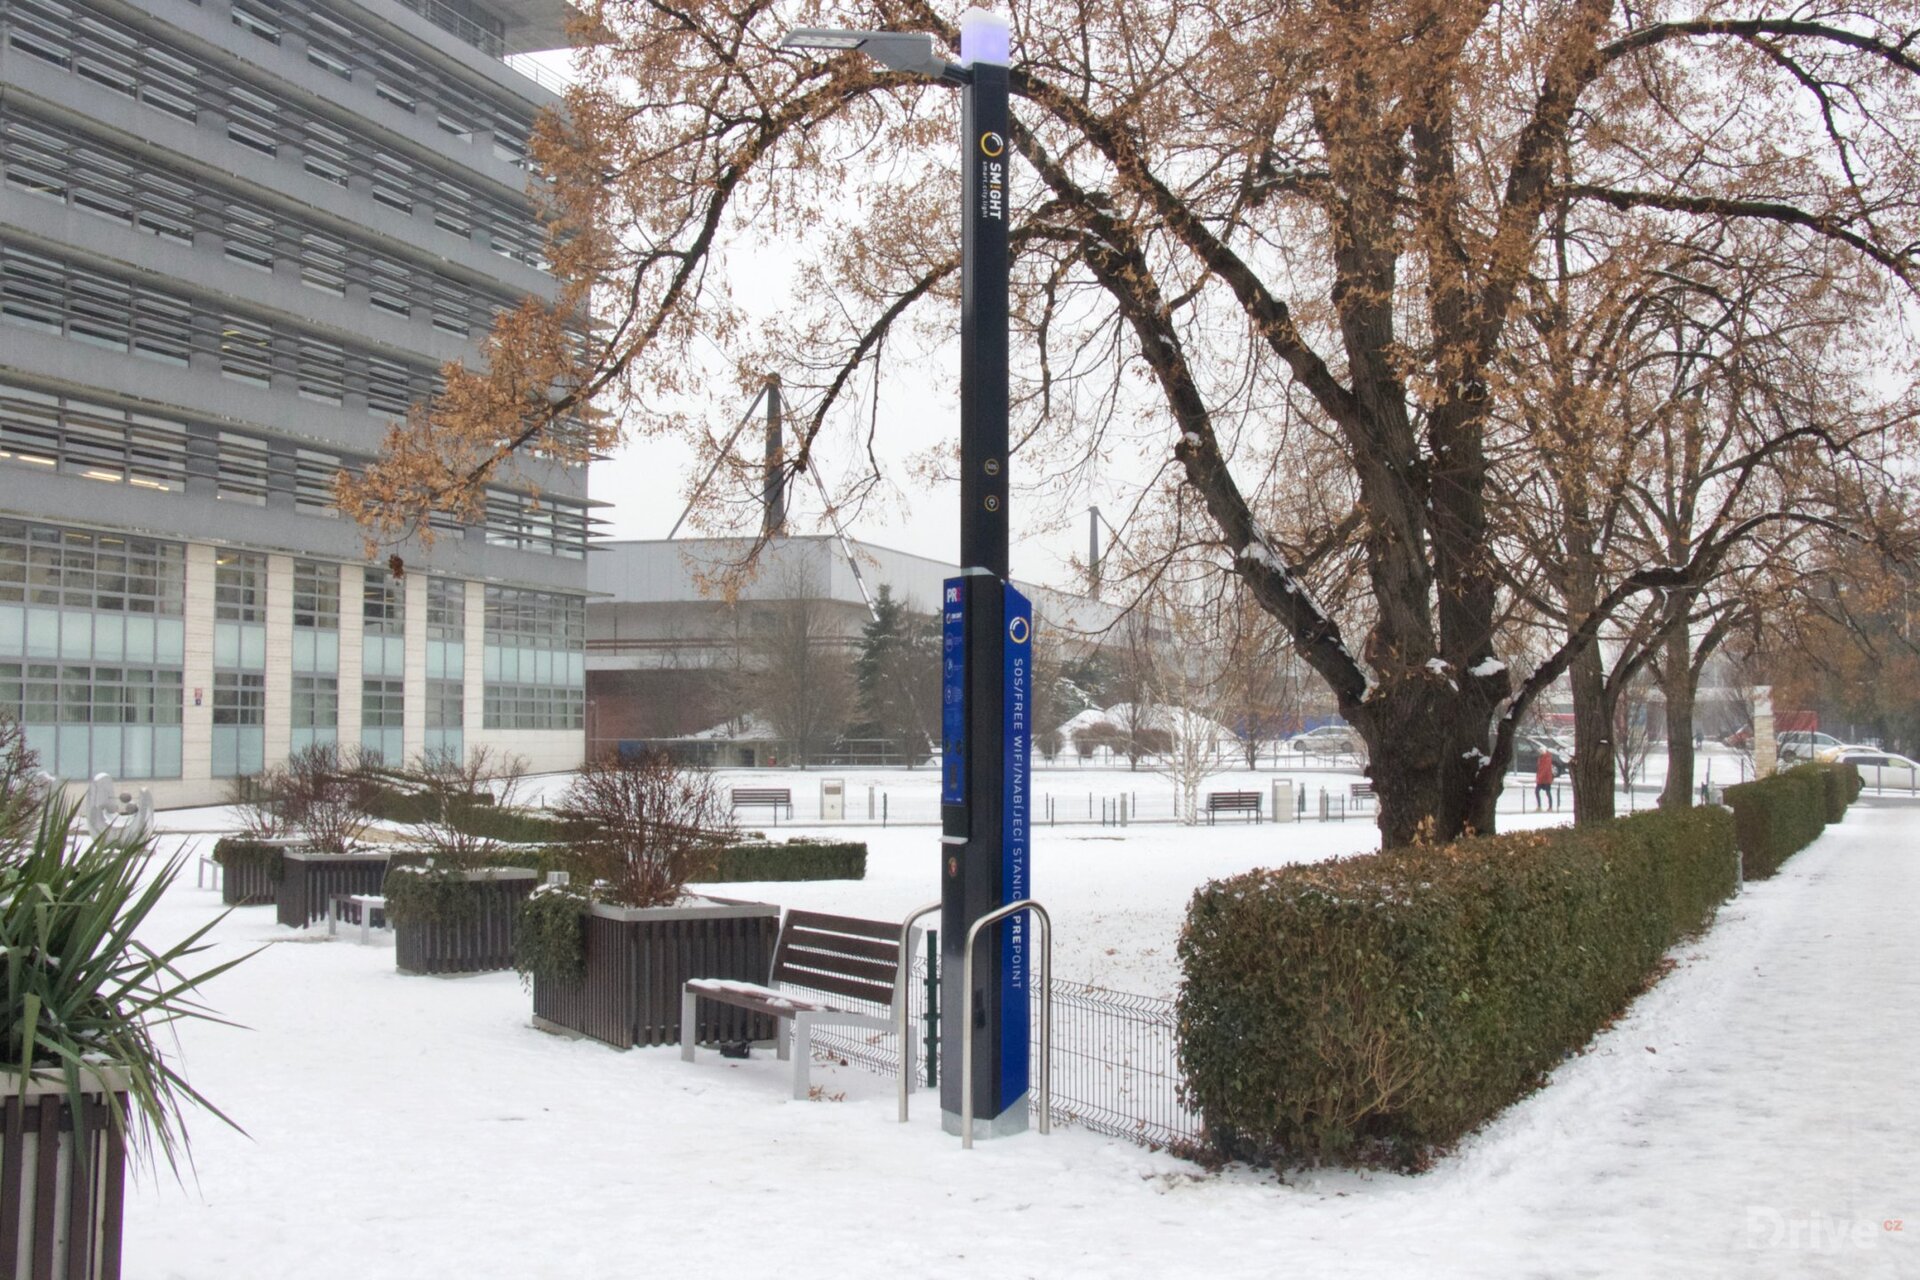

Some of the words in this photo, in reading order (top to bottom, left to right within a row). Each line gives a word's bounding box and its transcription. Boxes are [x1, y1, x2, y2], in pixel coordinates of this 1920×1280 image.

[1013, 658, 1023, 730] SOS/FREE
[1012, 735, 1025, 842] WIFI/NABÍJECÍ
[1012, 848, 1022, 902] STANIC
[1012, 915, 1022, 989] PREPOINT
